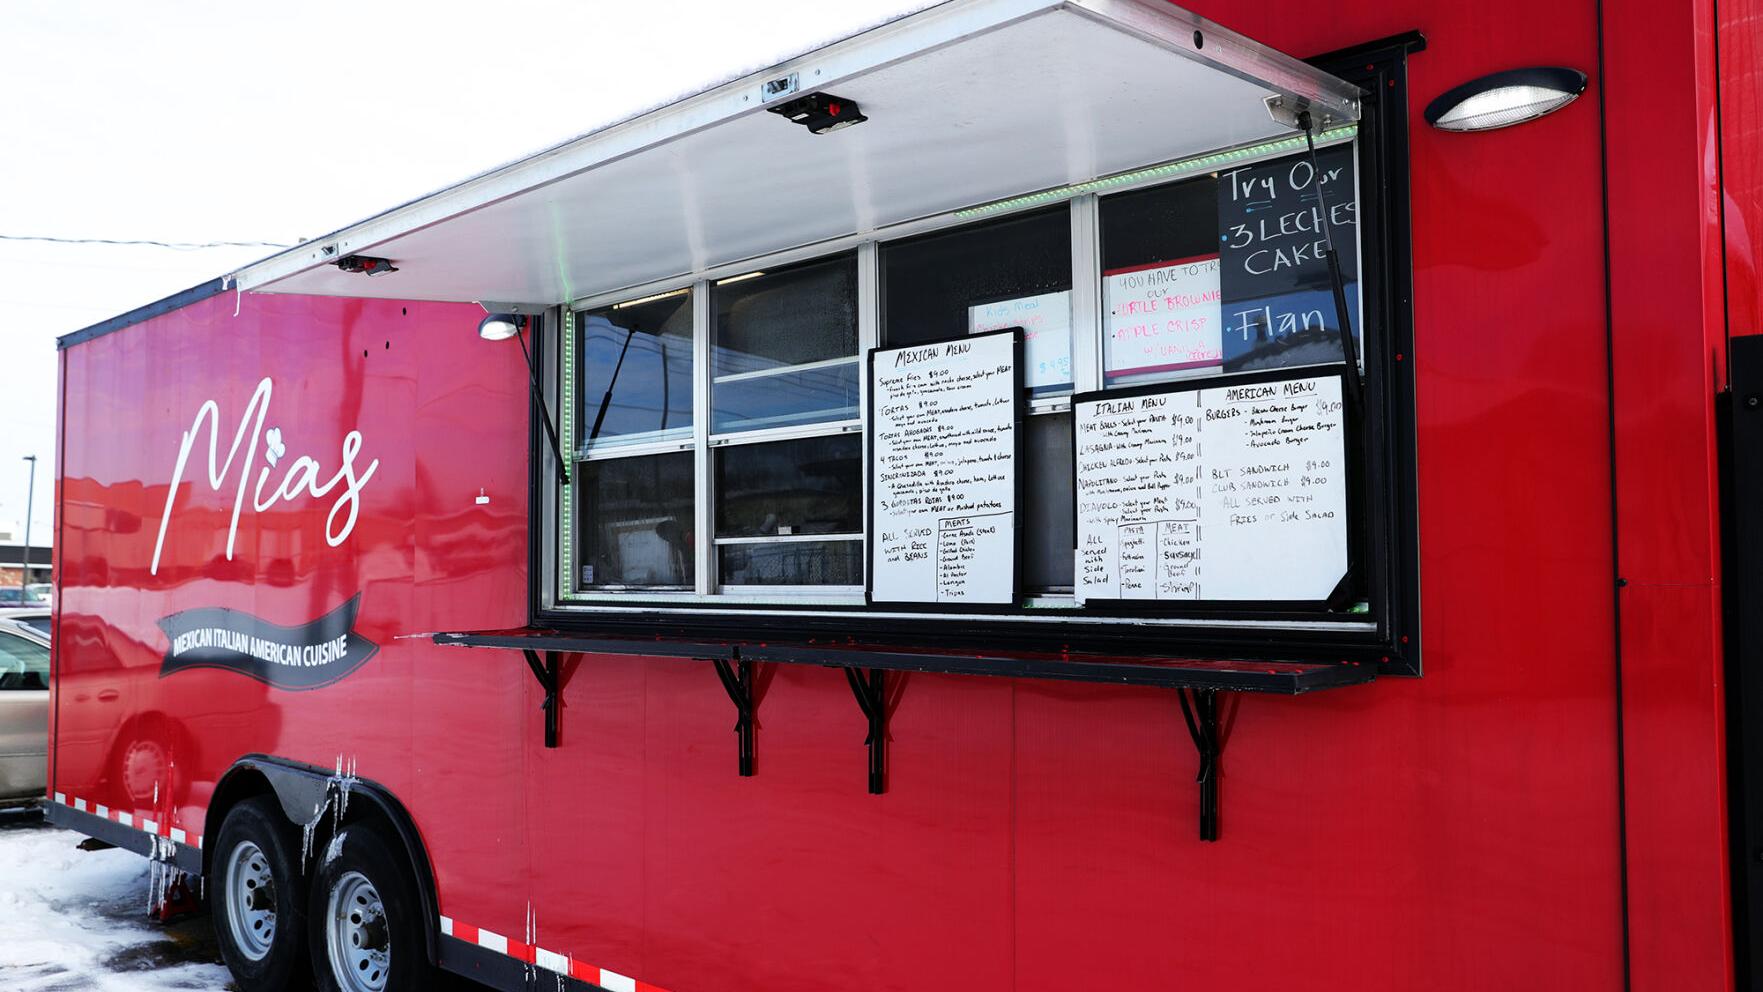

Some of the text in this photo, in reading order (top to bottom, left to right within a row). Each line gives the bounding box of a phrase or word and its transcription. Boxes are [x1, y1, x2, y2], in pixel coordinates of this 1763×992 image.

[1222, 161, 1343, 201] Try Our
[1230, 202, 1357, 248] 3 LECHES
[1245, 239, 1327, 275] CAKE
[1148, 269, 1177, 285] HAVE
[1182, 265, 1198, 275] TO
[1201, 261, 1216, 272] TR
[1233, 306, 1325, 341] Flan
[895, 344, 971, 368] MEXICAN MENU
[1226, 382, 1316, 400] AMERICAN MENU
[880, 405, 909, 416] TORTAS
[1093, 398, 1166, 417] ITALIAN MENU
[1206, 408, 1240, 421] BURGERS
[1212, 469, 1232, 479] BLT
[1240, 464, 1289, 476] SANDWICH
[1301, 475, 1327, 487] $9.00
[881, 501, 888, 511] 3
[945, 519, 970, 528] MEATS
[905, 552, 928, 561] BEANS
[173, 628, 347, 667] MEXICAN ITALIAN AMERICAN CUISINE
